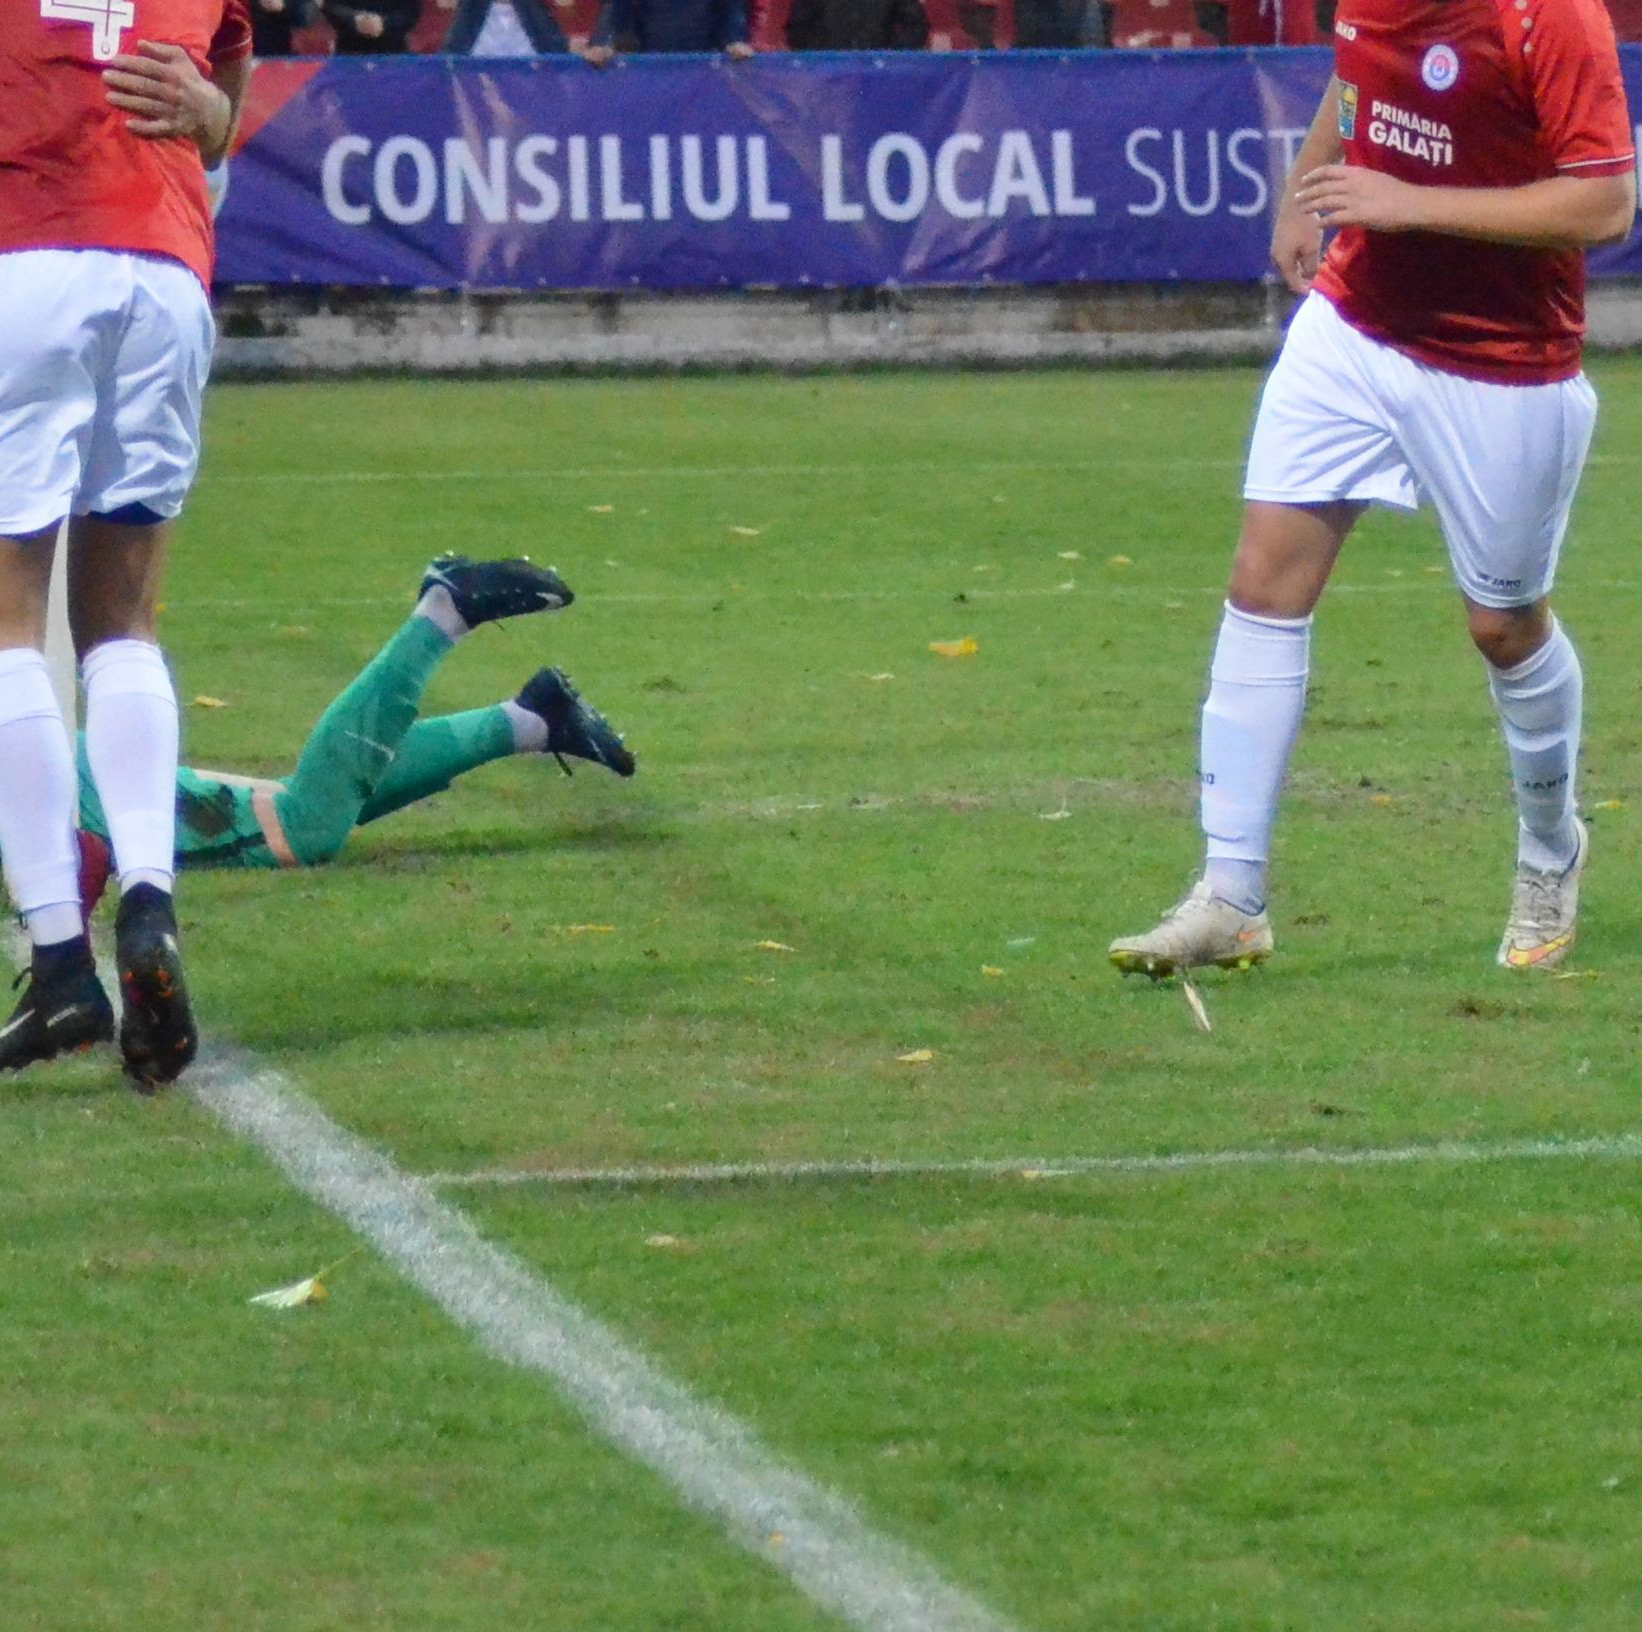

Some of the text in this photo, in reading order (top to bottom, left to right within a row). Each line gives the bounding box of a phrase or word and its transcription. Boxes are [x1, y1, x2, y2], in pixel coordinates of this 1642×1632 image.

[321, 134, 791, 225] CONSILIUL
[821, 130, 1097, 223] LOCAL
[1125, 127, 1307, 216] SUST
